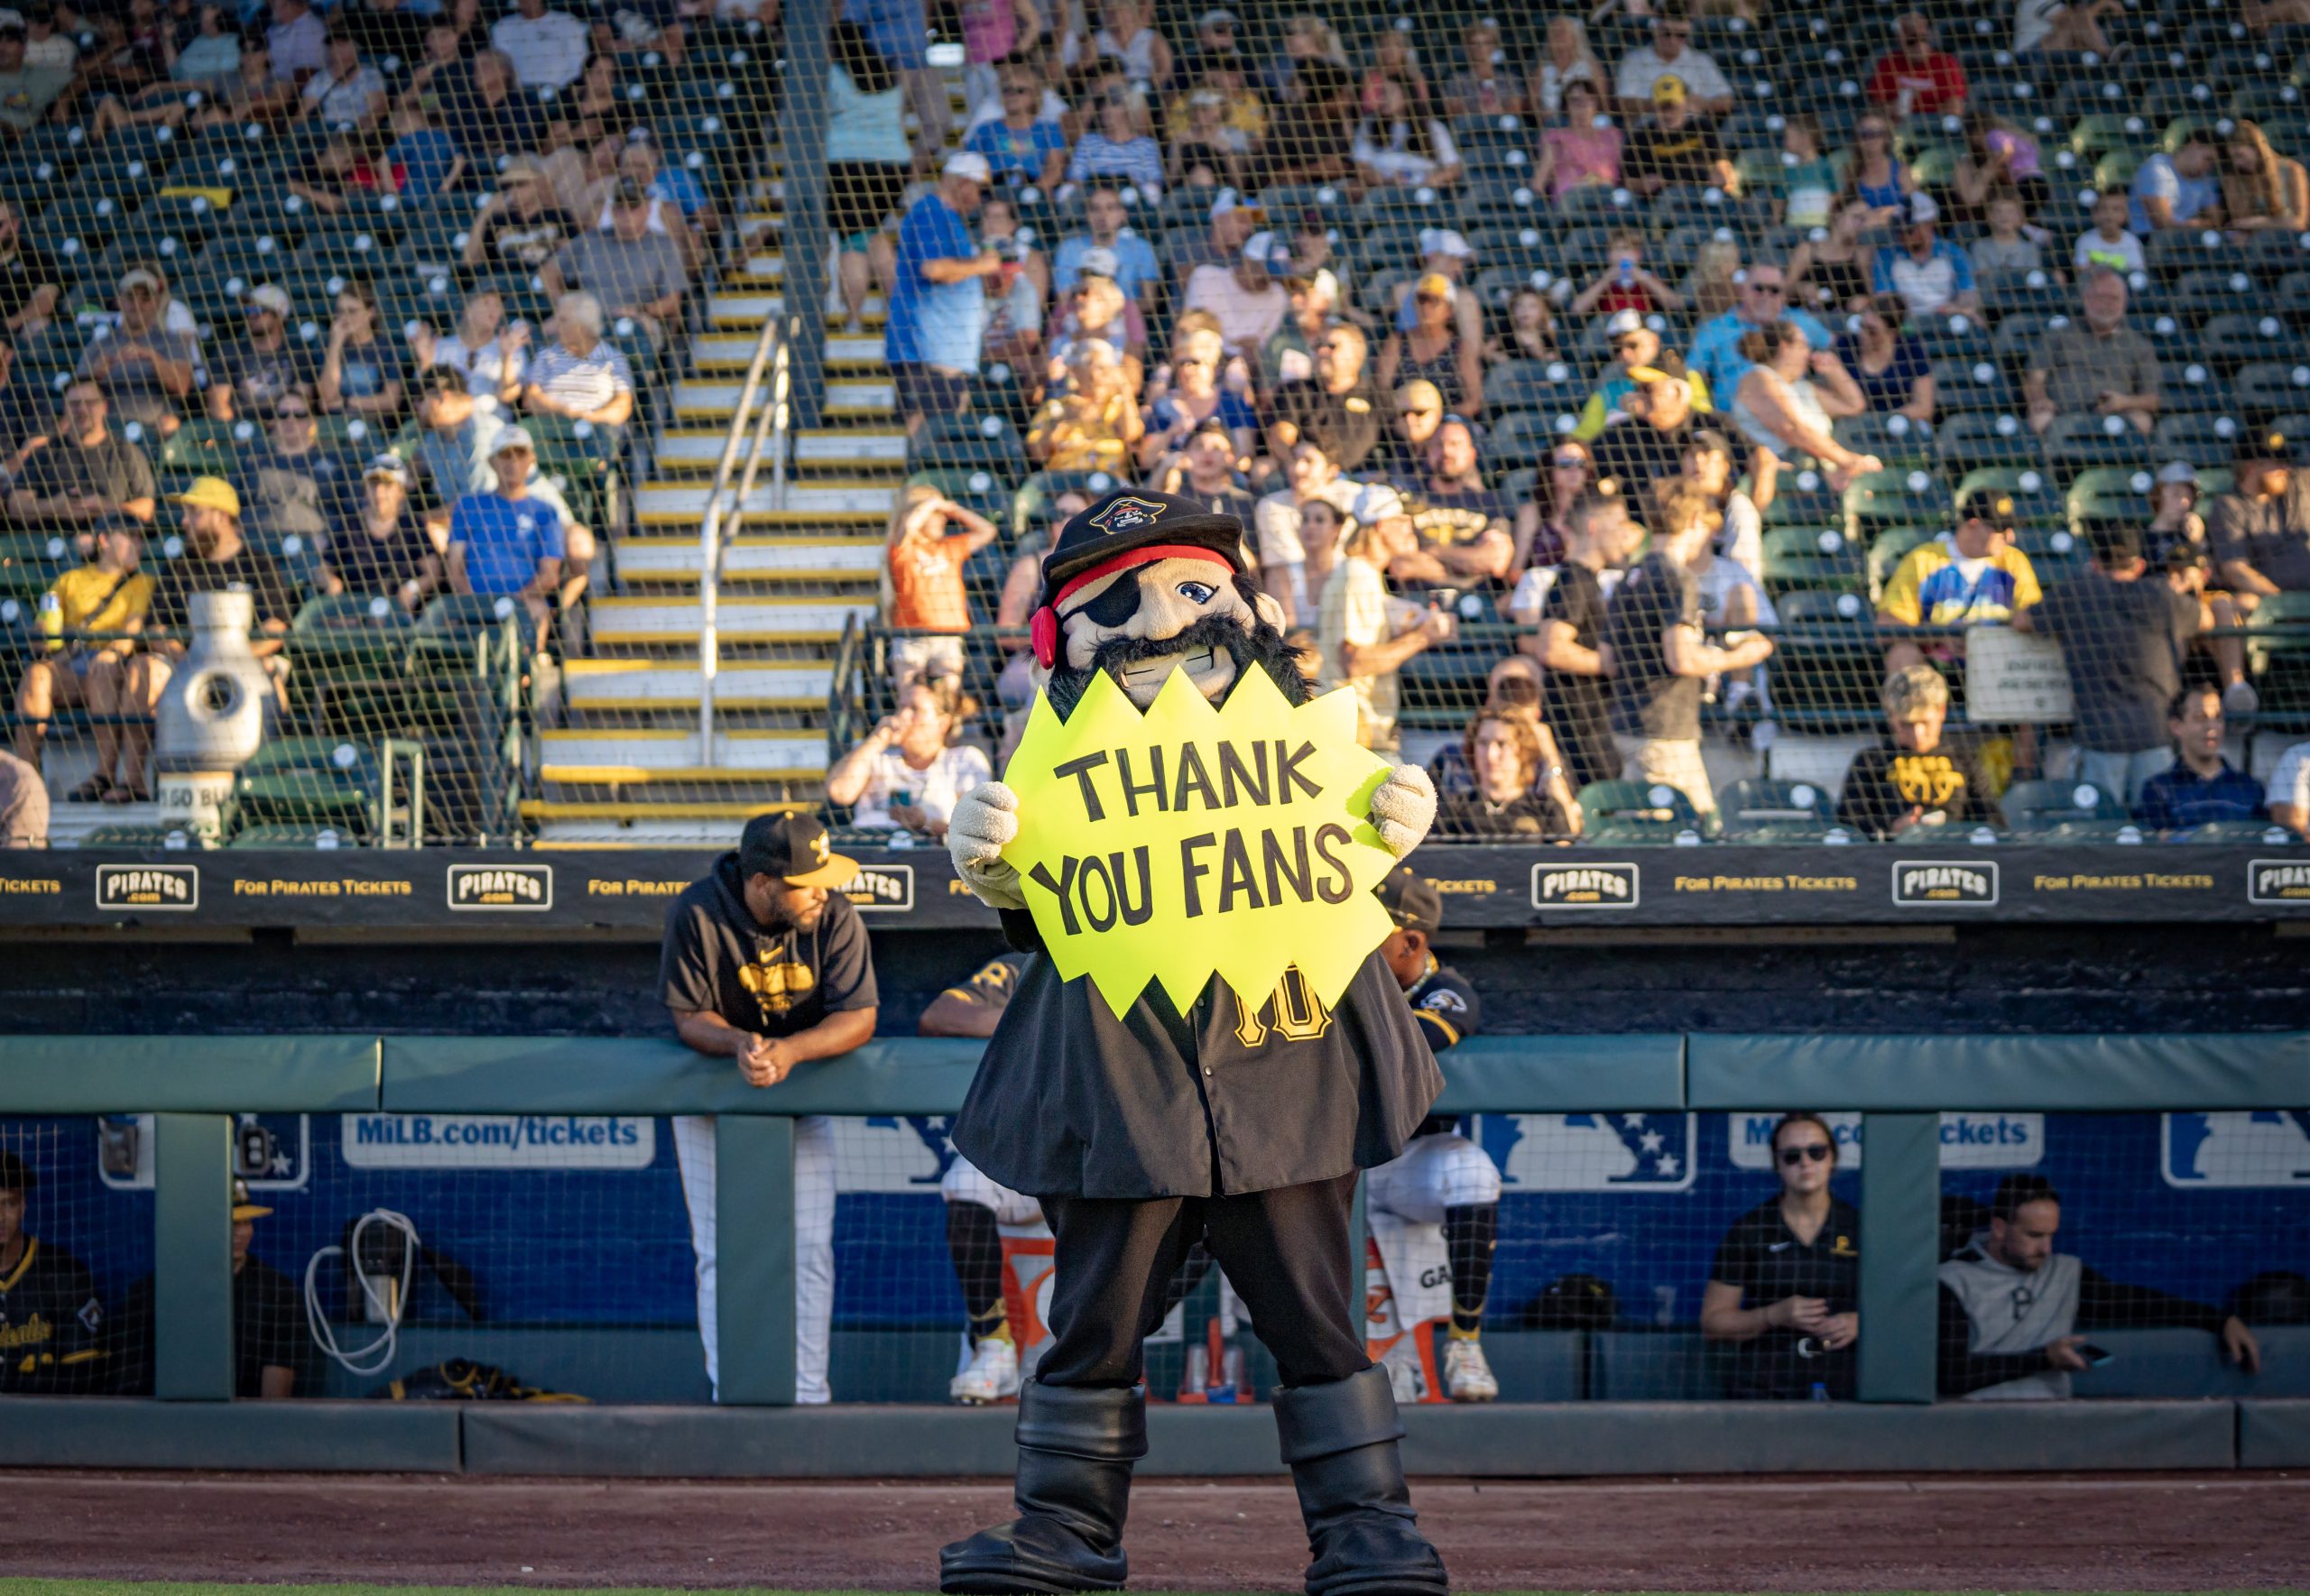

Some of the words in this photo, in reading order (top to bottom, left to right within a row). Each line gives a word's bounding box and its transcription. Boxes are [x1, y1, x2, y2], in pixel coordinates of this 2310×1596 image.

[1053, 740, 1324, 822] THANK
[107, 871, 187, 899] PIRATES
[458, 871, 541, 900] PIRATES
[625, 879, 691, 895] PIRATE
[1028, 844, 1153, 936] YOU
[1180, 823, 1353, 918] FANS
[1543, 870, 1628, 899] PIRATES
[1904, 867, 1987, 896] PIRATES
[356, 1116, 639, 1150] MiLB.com/tickets
[1419, 1265, 1453, 1290] GA
